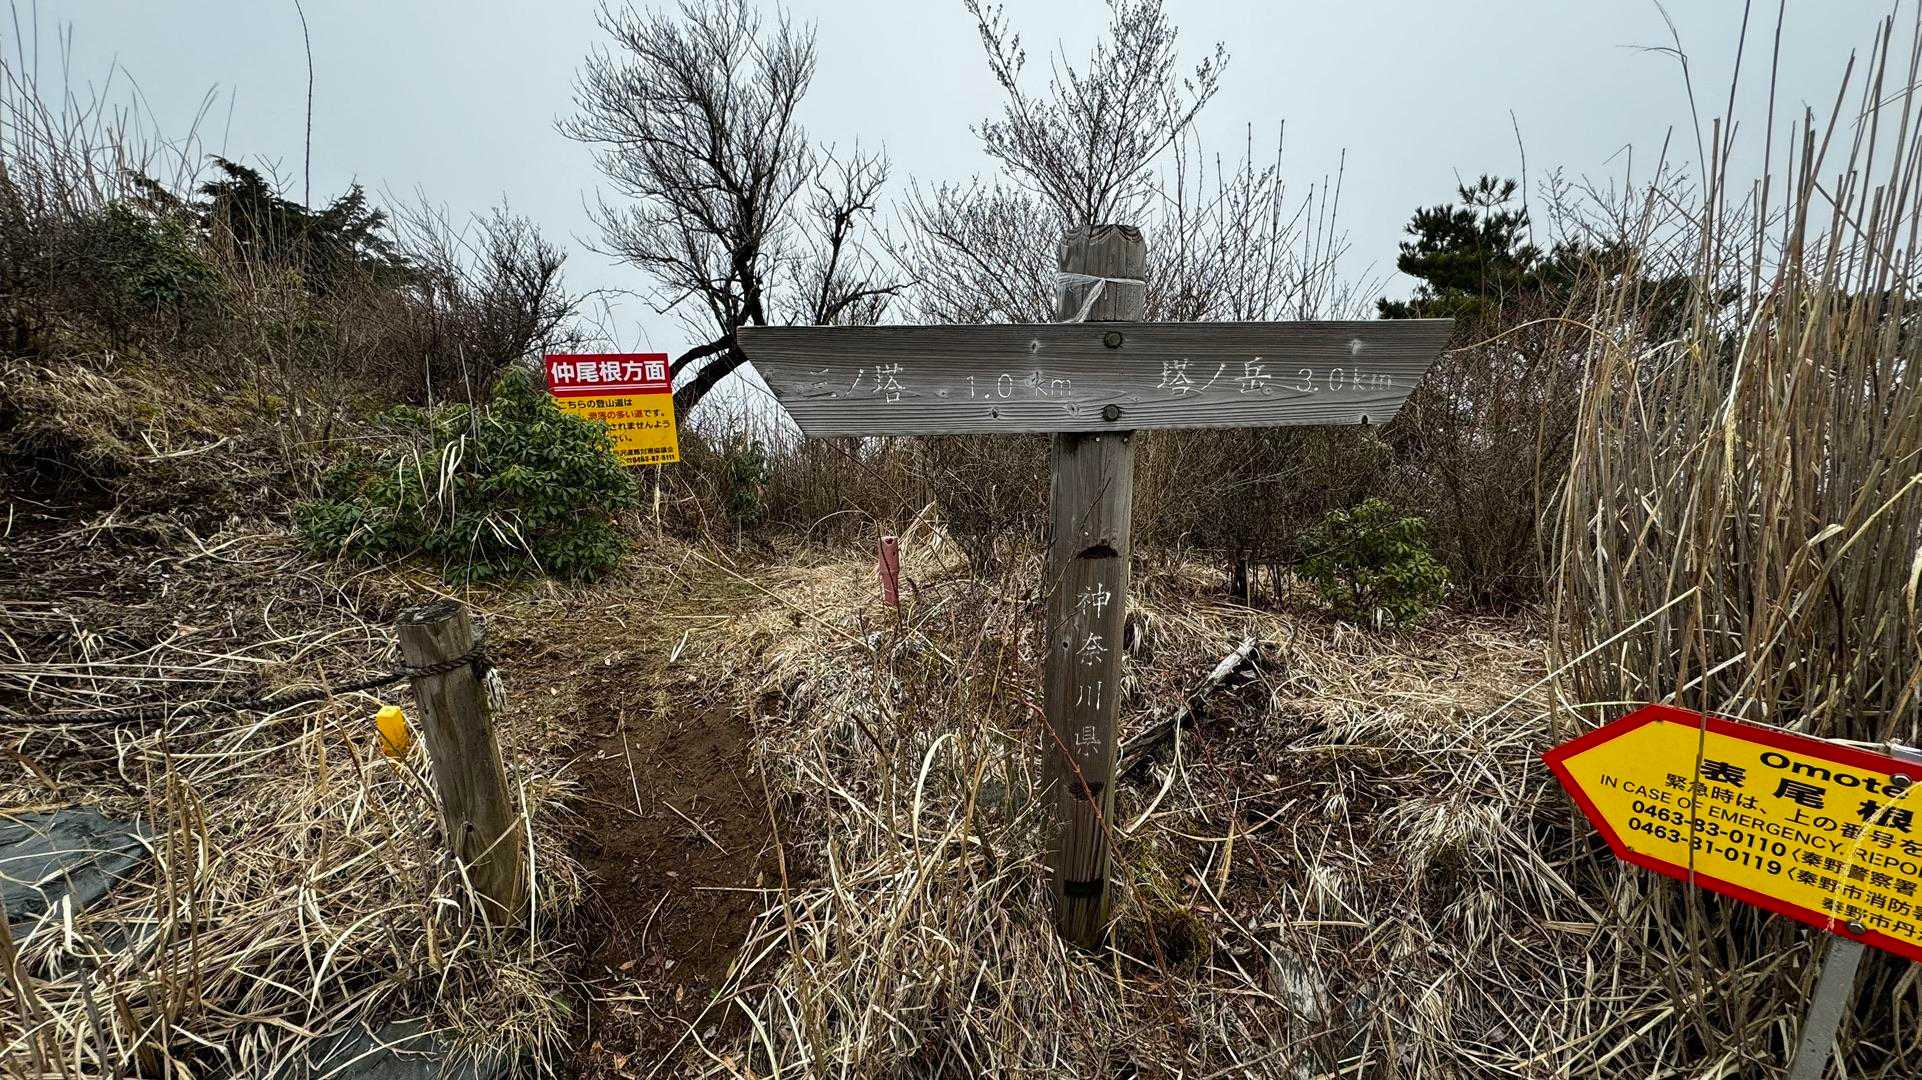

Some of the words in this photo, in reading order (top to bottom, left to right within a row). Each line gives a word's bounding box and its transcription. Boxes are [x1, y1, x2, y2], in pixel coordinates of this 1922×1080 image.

[551, 360, 666, 384] 仲尾根方面
[1156, 356, 1272, 395] 塔ノ岳
[1075, 582, 1111, 756] 神奈川県
[1600, 774, 1617, 789] IN
[1623, 780, 1673, 804] CASE
[1677, 796, 1704, 810] OF
[1822, 896, 1922, 941] 秦野市丹
